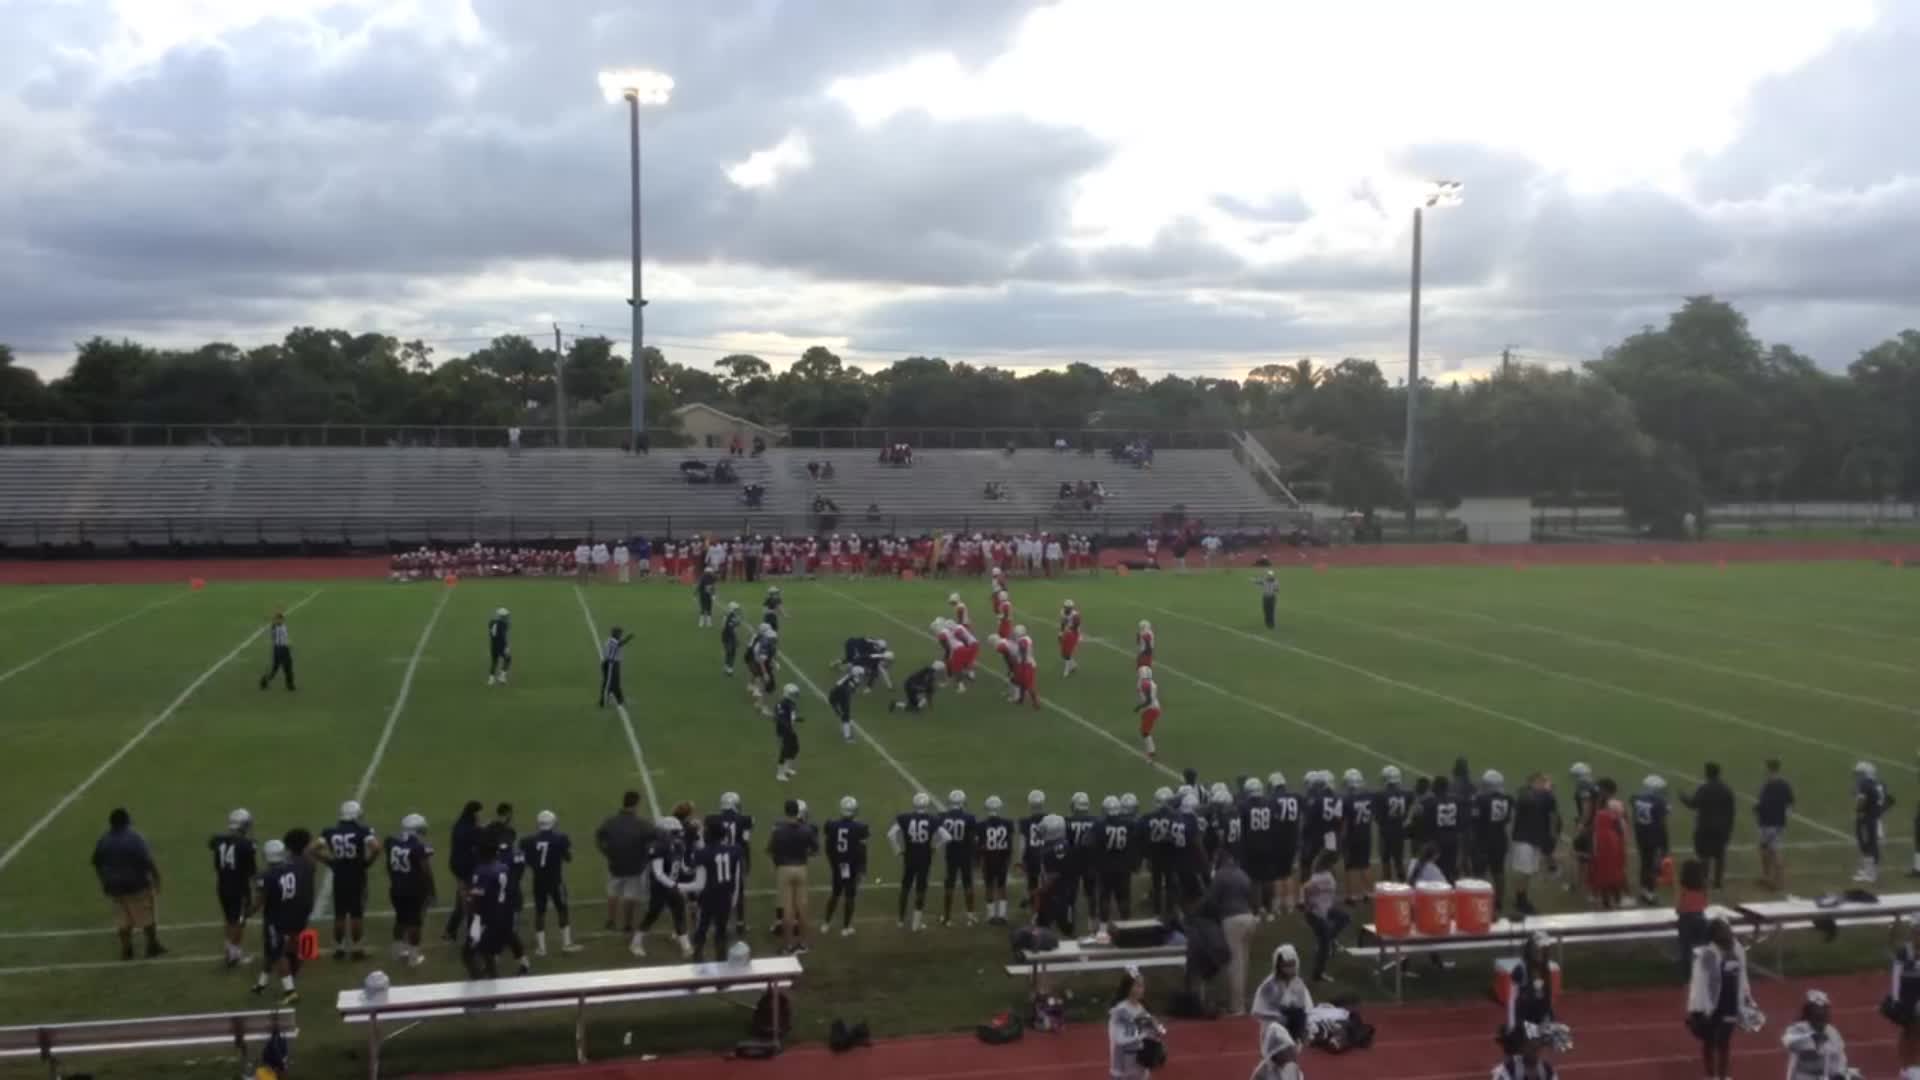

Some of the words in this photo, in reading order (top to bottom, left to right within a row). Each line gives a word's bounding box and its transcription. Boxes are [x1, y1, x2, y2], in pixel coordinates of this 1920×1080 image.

[1277, 797, 1298, 821] 79
[1322, 797, 1343, 821] 54
[837, 827, 849, 852] 5
[908, 818, 929, 842] 46
[986, 827, 1008, 850] 82
[1105, 826, 1127, 850] 76
[219, 842, 236, 870] 14
[331, 832, 357, 859] 65
[536, 841, 549, 868] 7
[715, 852, 731, 883] 11
[279, 872, 297, 901] 19
